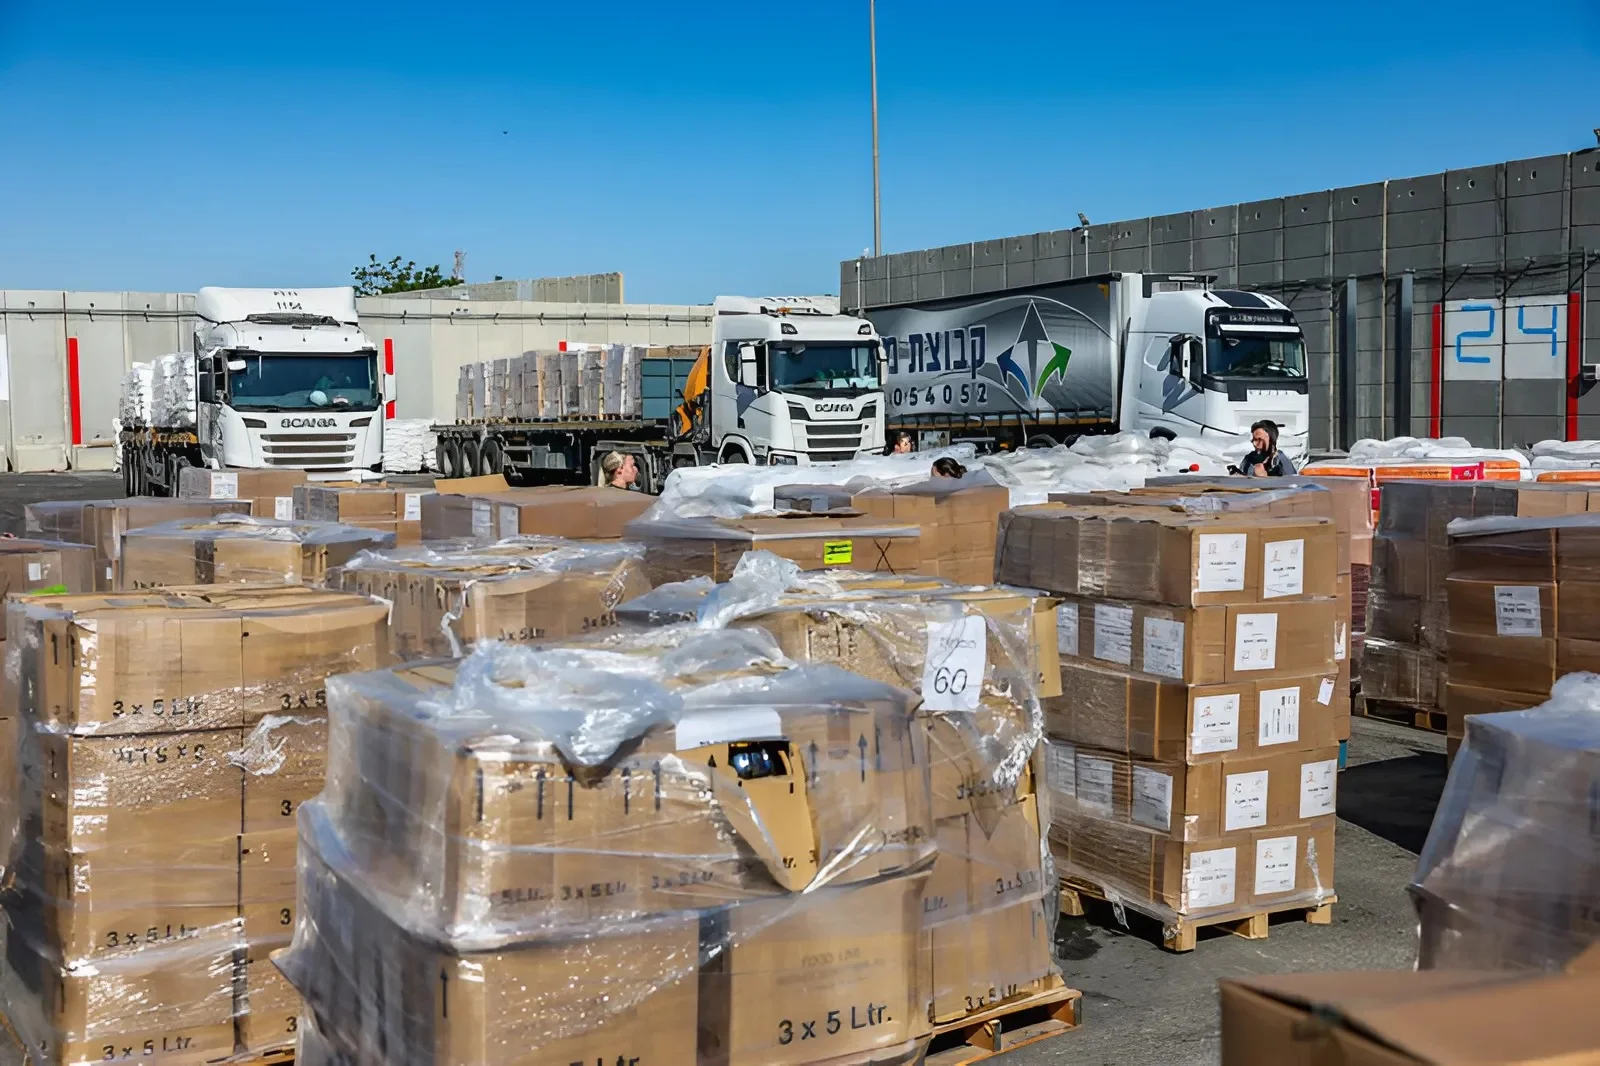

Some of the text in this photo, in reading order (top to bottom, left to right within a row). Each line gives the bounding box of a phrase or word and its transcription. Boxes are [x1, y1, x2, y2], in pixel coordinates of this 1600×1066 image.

[1456, 304, 1558, 364] 24
[909, 326, 985, 380] קבוצת
[934, 666, 968, 696] 60
[112, 700, 125, 717] 3
[152, 698, 165, 716] 5
[280, 693, 292, 711] 3
[280, 798, 293, 816] 3
[280, 908, 292, 925] 3
[106, 931, 119, 948] 3
[146, 926, 159, 944] 5
[285, 1015, 298, 1033] 3
[779, 1001, 892, 1045] 3 x 5 Ltr.
[103, 1045, 116, 1061] 3
